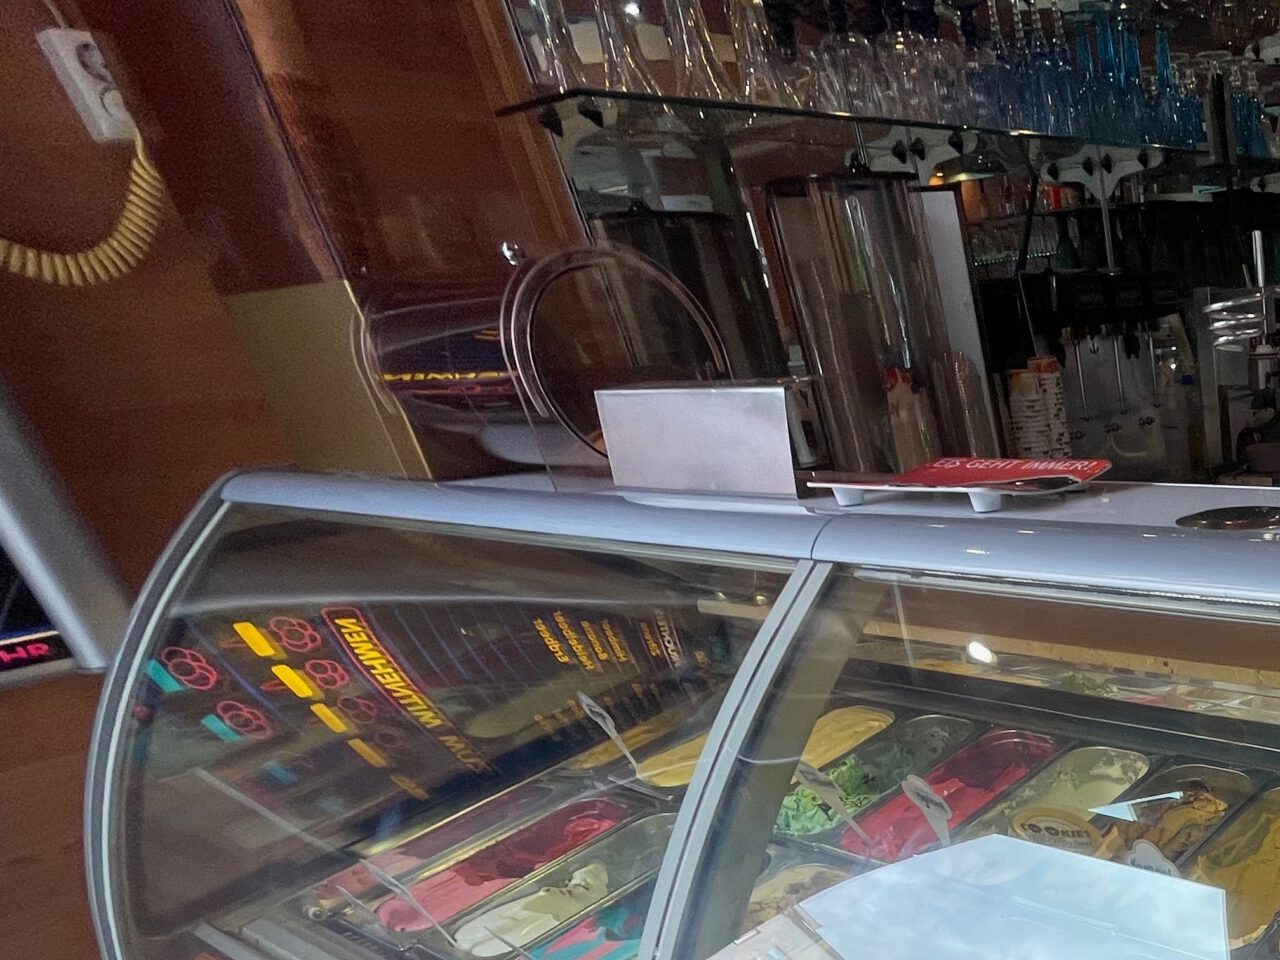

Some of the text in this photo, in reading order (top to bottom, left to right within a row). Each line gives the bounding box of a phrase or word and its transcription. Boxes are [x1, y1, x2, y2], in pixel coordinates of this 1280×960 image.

[932, 457, 1098, 471] EIS GEHT IMMER!
